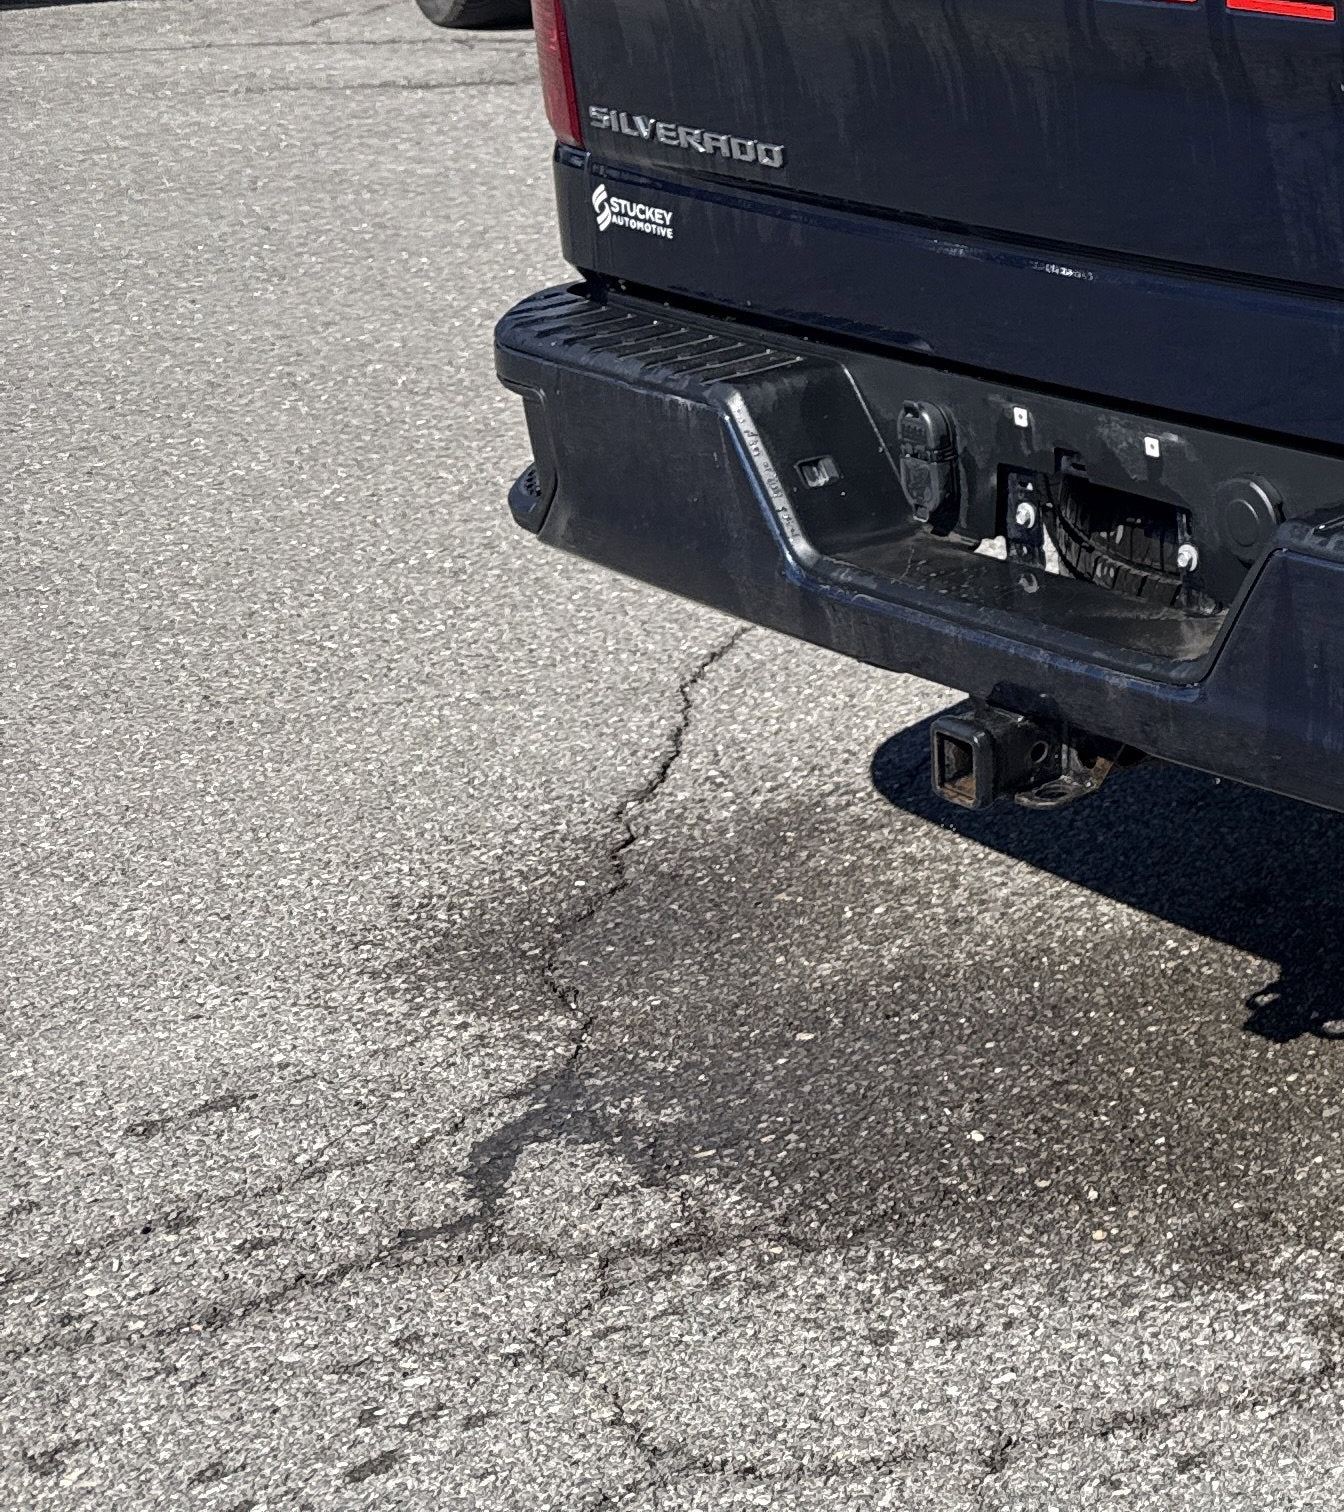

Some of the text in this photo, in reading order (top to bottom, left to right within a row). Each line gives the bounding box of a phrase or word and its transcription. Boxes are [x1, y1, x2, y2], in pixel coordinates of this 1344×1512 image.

[589, 105, 785, 168] SILVERADO
[610, 197, 673, 226] STUCKEY
[611, 214, 674, 239] AUTOMOTIVE
